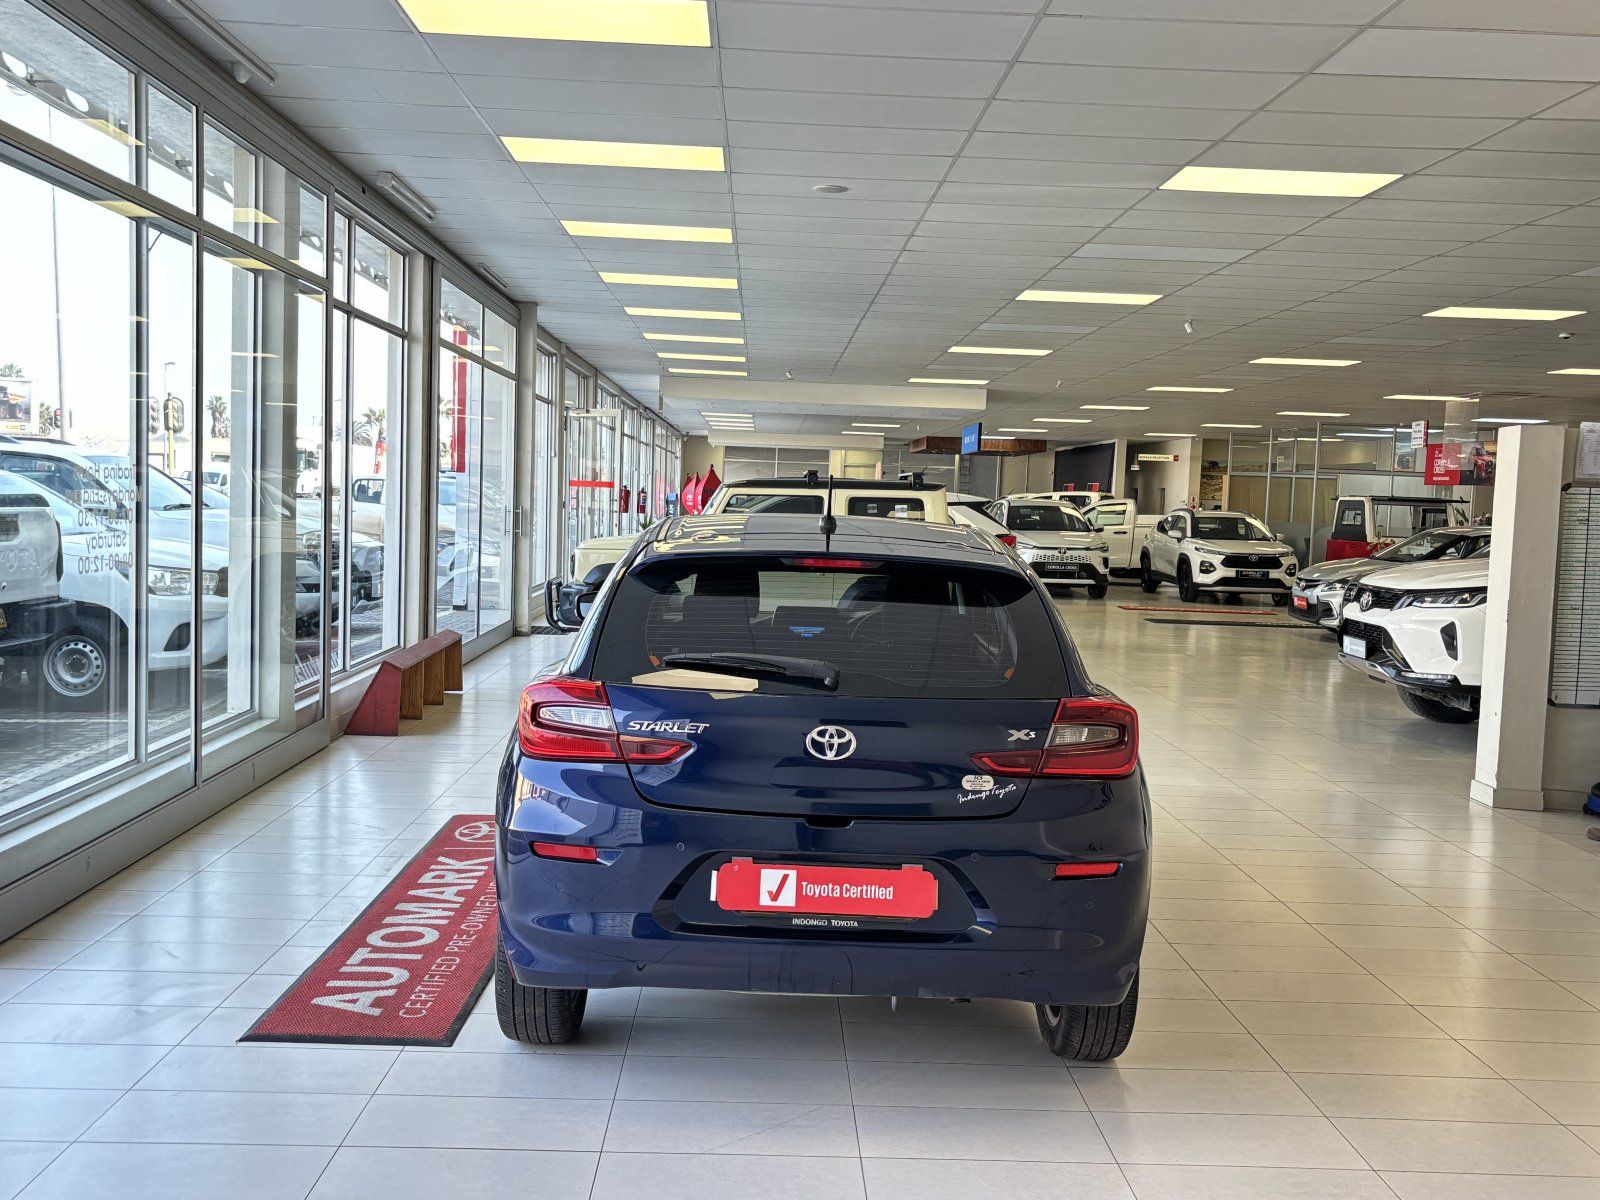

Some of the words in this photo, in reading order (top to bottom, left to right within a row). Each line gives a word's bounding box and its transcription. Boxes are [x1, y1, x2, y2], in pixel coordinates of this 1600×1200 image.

[627, 720, 710, 734] STARLET
[991, 784, 1017, 799] Toyota
[801, 881, 840, 898] Toyota
[842, 884, 894, 900] Certified
[792, 918, 828, 926] INDONGO
[830, 919, 859, 927] TOYOTA
[311, 856, 495, 1016] AUTOMARK
[399, 957, 460, 1018] CERTIFIED
